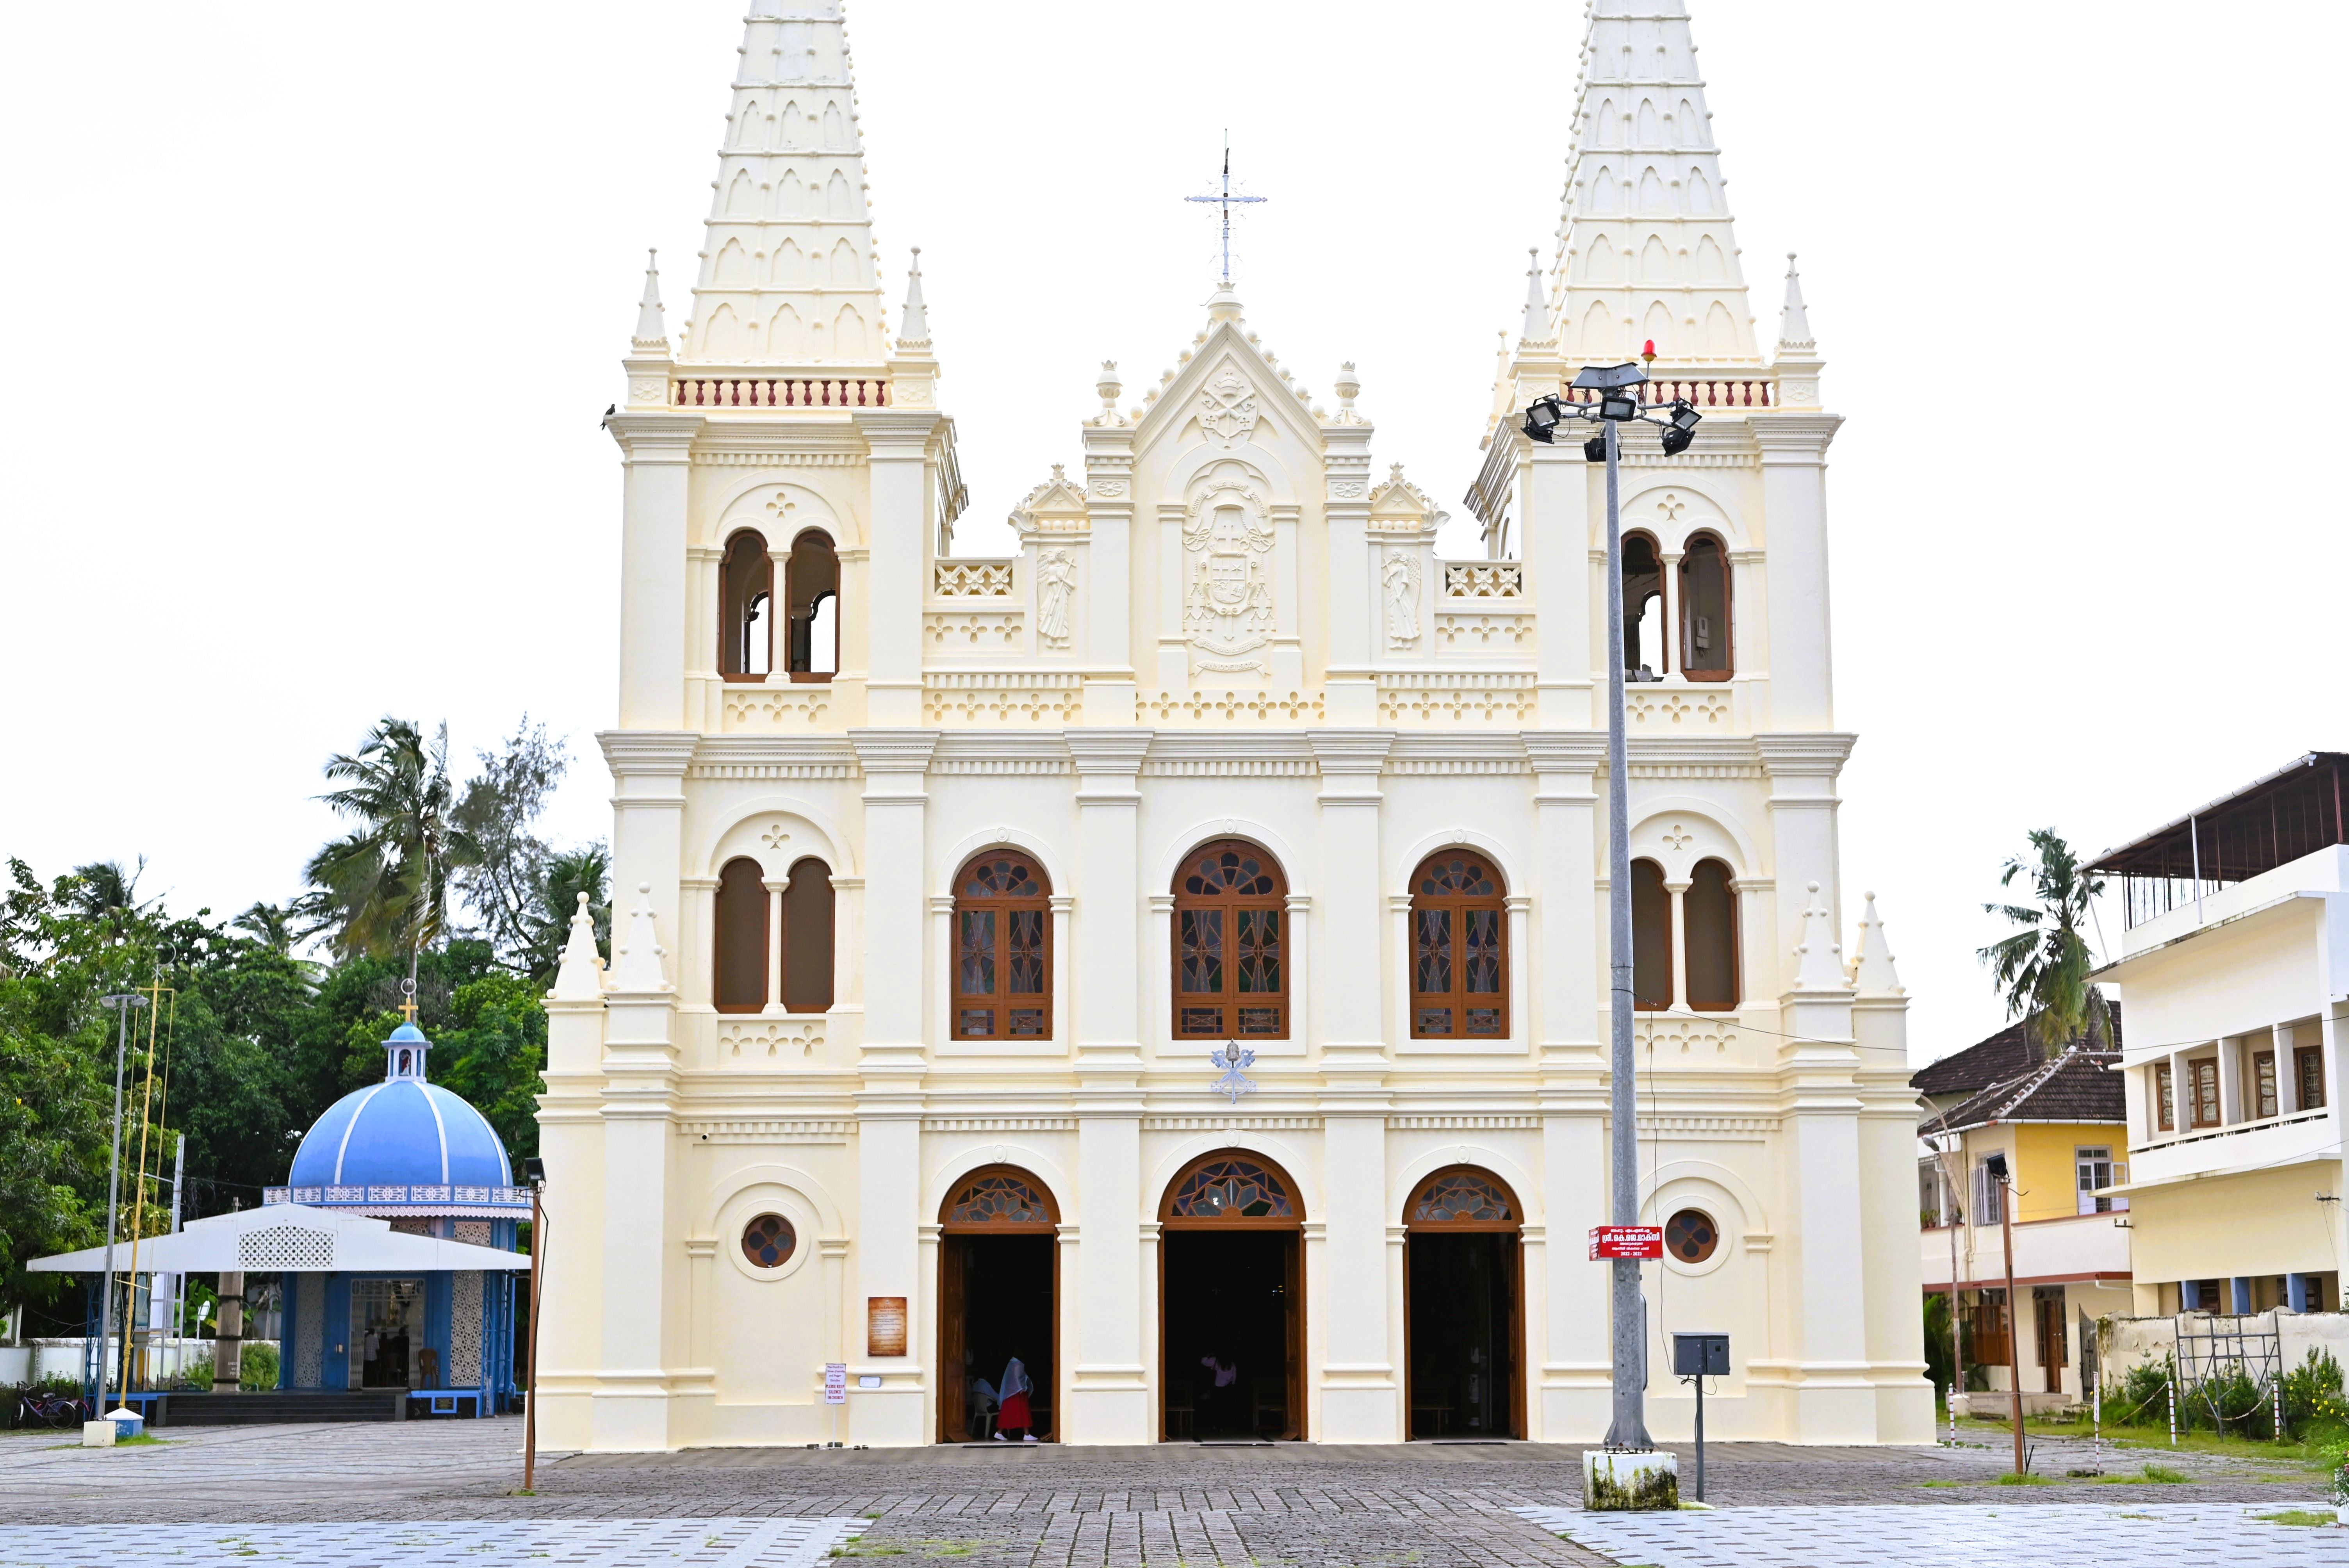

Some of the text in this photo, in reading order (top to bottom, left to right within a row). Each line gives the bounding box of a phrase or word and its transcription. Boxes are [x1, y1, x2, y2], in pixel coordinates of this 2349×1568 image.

[1191, 491, 1205, 514] CARITAS
[1251, 492, 1265, 516] POTESTAS
[1237, 662, 1254, 670] 1902
